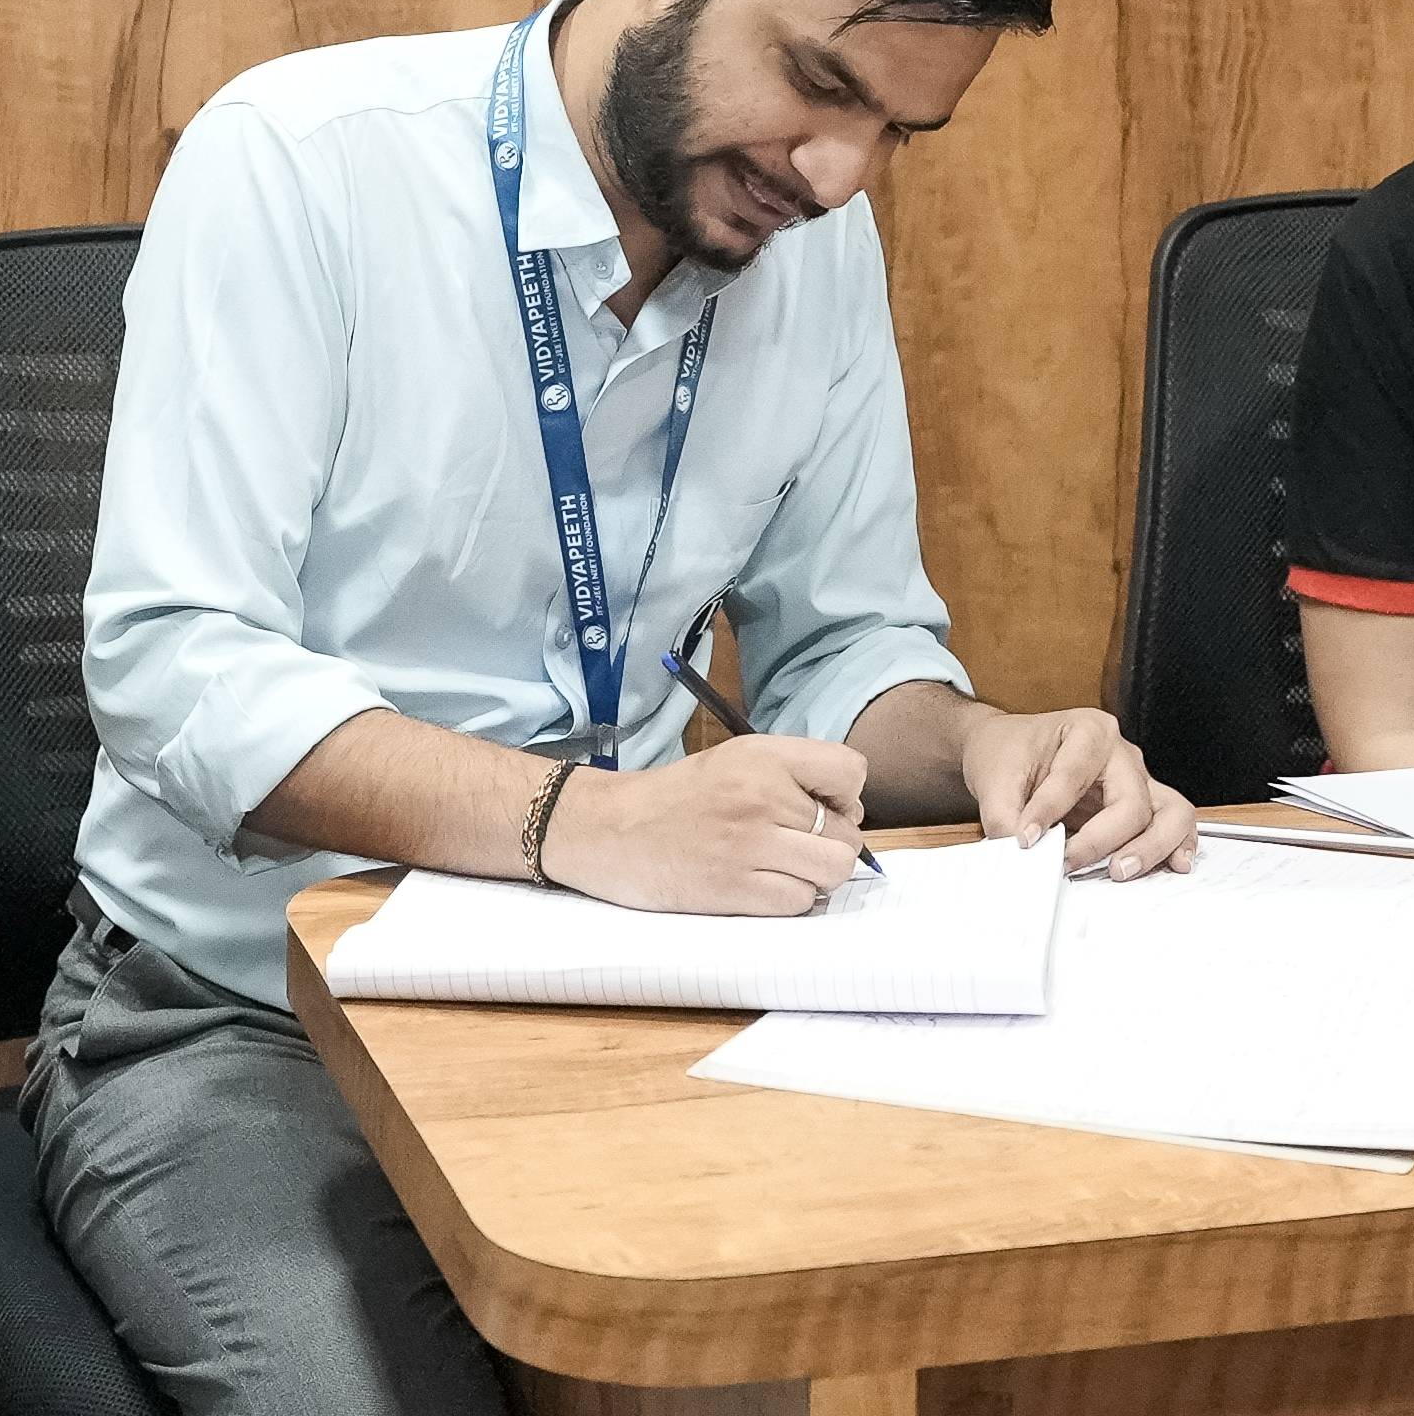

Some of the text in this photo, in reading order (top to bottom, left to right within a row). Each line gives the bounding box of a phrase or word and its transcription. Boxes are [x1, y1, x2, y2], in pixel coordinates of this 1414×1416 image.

[516, 252, 555, 383] VIDYAPEETH
[536, 251, 555, 311] FOUNDATION
[559, 494, 594, 621] VIDYAPEETH
[579, 492, 595, 554] FOUNDATION
